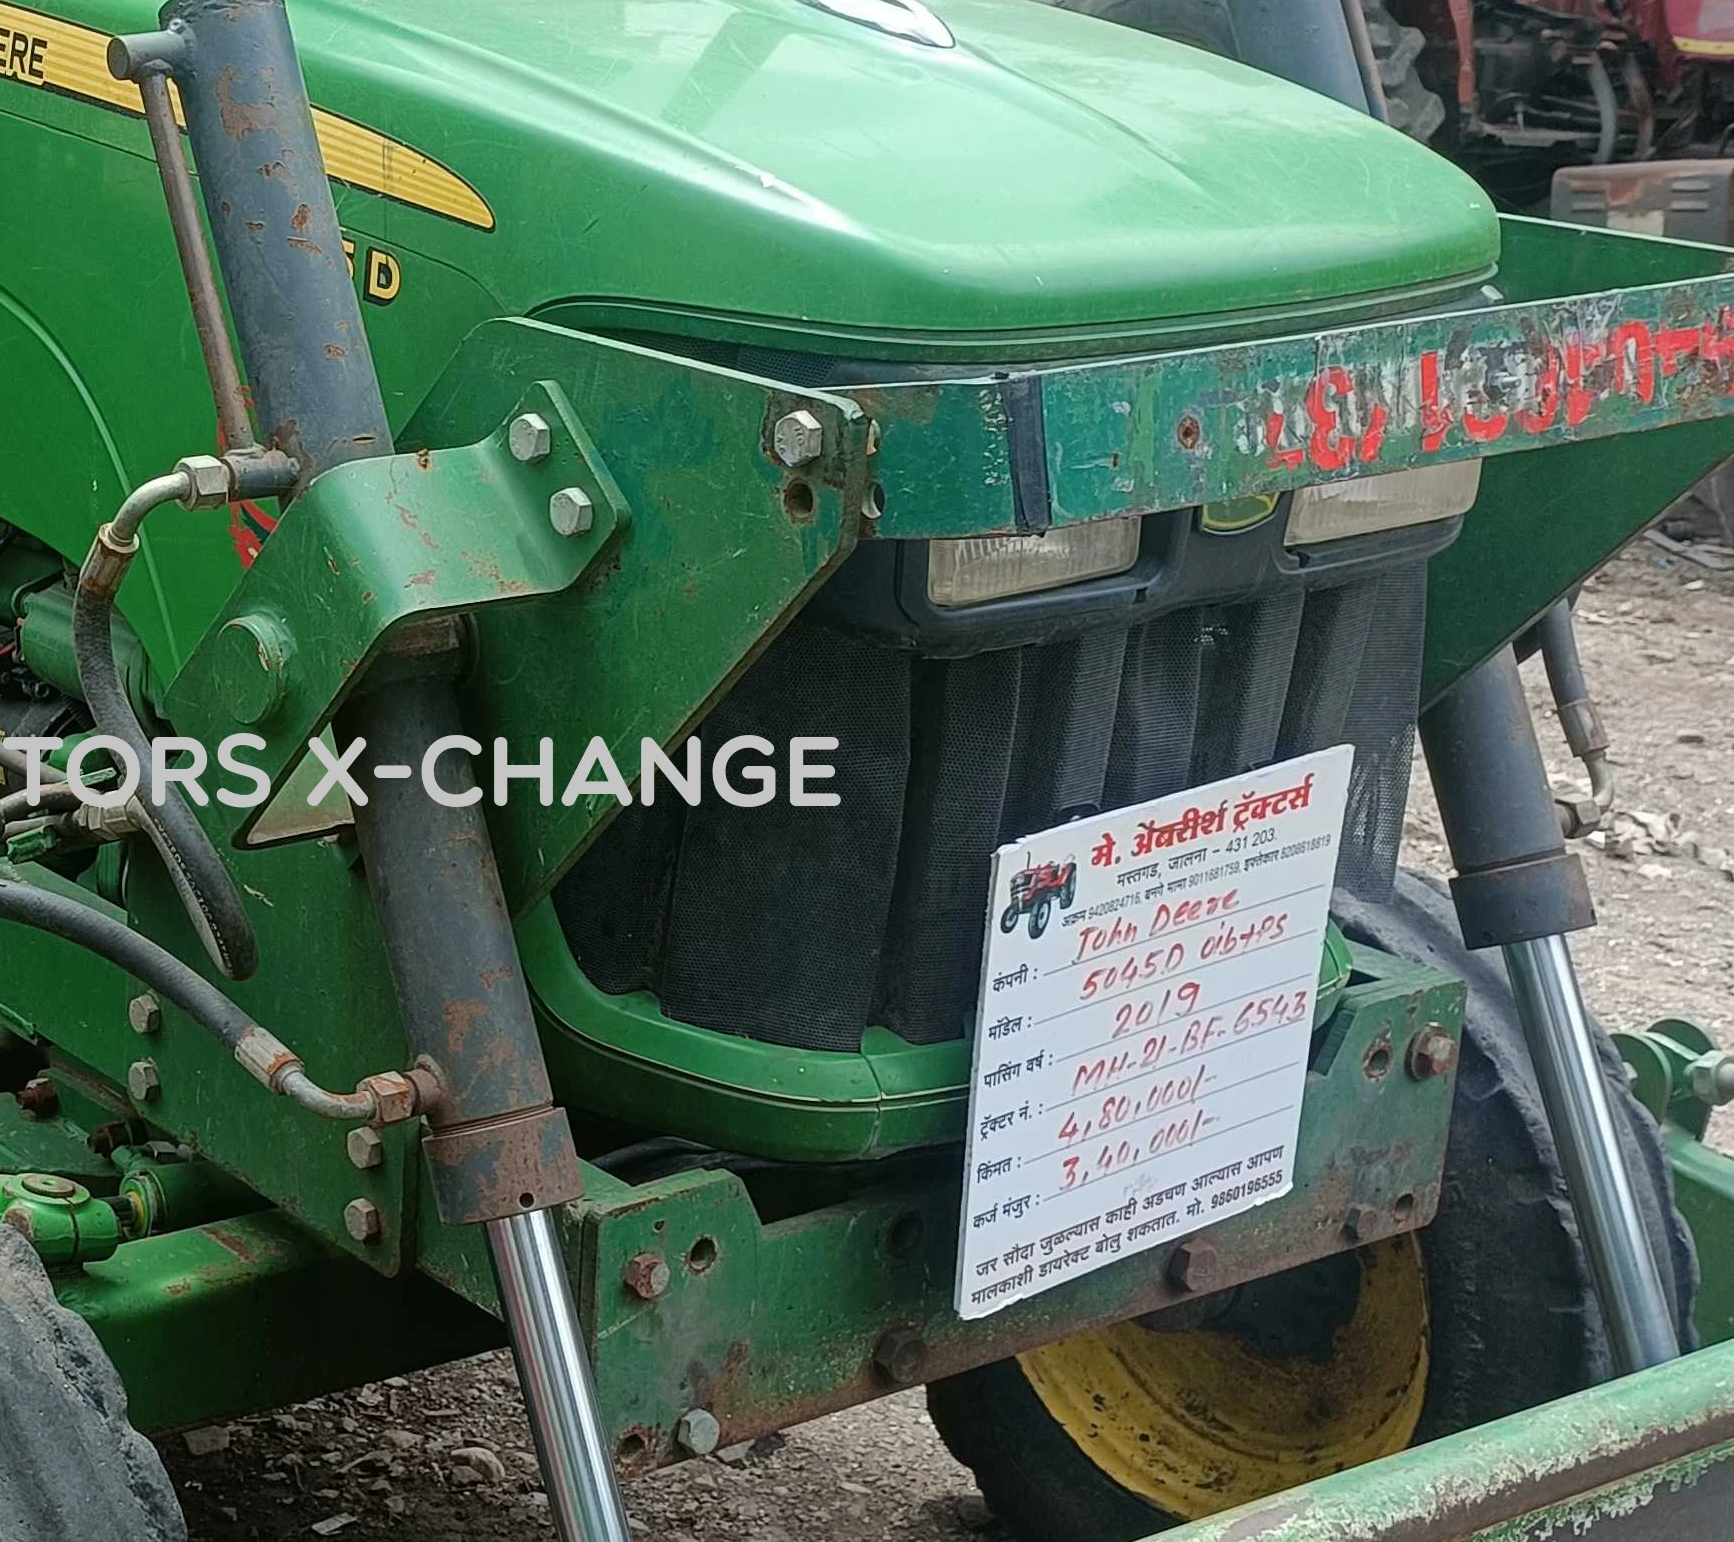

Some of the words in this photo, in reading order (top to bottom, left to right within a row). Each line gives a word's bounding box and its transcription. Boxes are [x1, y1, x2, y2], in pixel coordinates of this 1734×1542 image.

[1233, 773, 1314, 833] ट्रॅक्टर्स
[1169, 848, 1207, 869] जालना
[1226, 836, 1249, 852] 431
[993, 966, 1029, 992] कंपनी
[1072, 918, 1137, 964] John
[1150, 889, 1240, 937] Deere
[984, 1063, 1021, 1087] पासिंग
[1026, 1051, 1044, 1072] वर्ष
[1112, 981, 1201, 1039] 2019
[989, 1017, 1023, 1040] मॉडेल
[980, 1111, 1014, 1140] ट्रॅक्टर
[977, 1157, 1012, 1183] किंमत
[974, 1203, 998, 1228] कर्ज
[1003, 1195, 1031, 1218] मंजुर
[976, 1257, 998, 1275] जर
[1003, 1243, 1035, 1266] सौदा
[1040, 1216, 1101, 1255] जुळल्यास
[1106, 1197, 1138, 1224] काही
[1142, 1182, 1187, 1210] अडचण
[1191, 1161, 1242, 1190] आल्यास
[1247, 1145, 1284, 1169] आपण
[971, 1265, 1034, 1304] मालकाशी
[1039, 1245, 1090, 1277] डायरेक्ट
[1095, 1233, 1122, 1253] बोलु
[1127, 1211, 1179, 1241] शकतात.
[1187, 1198, 1204, 1216] मो.
